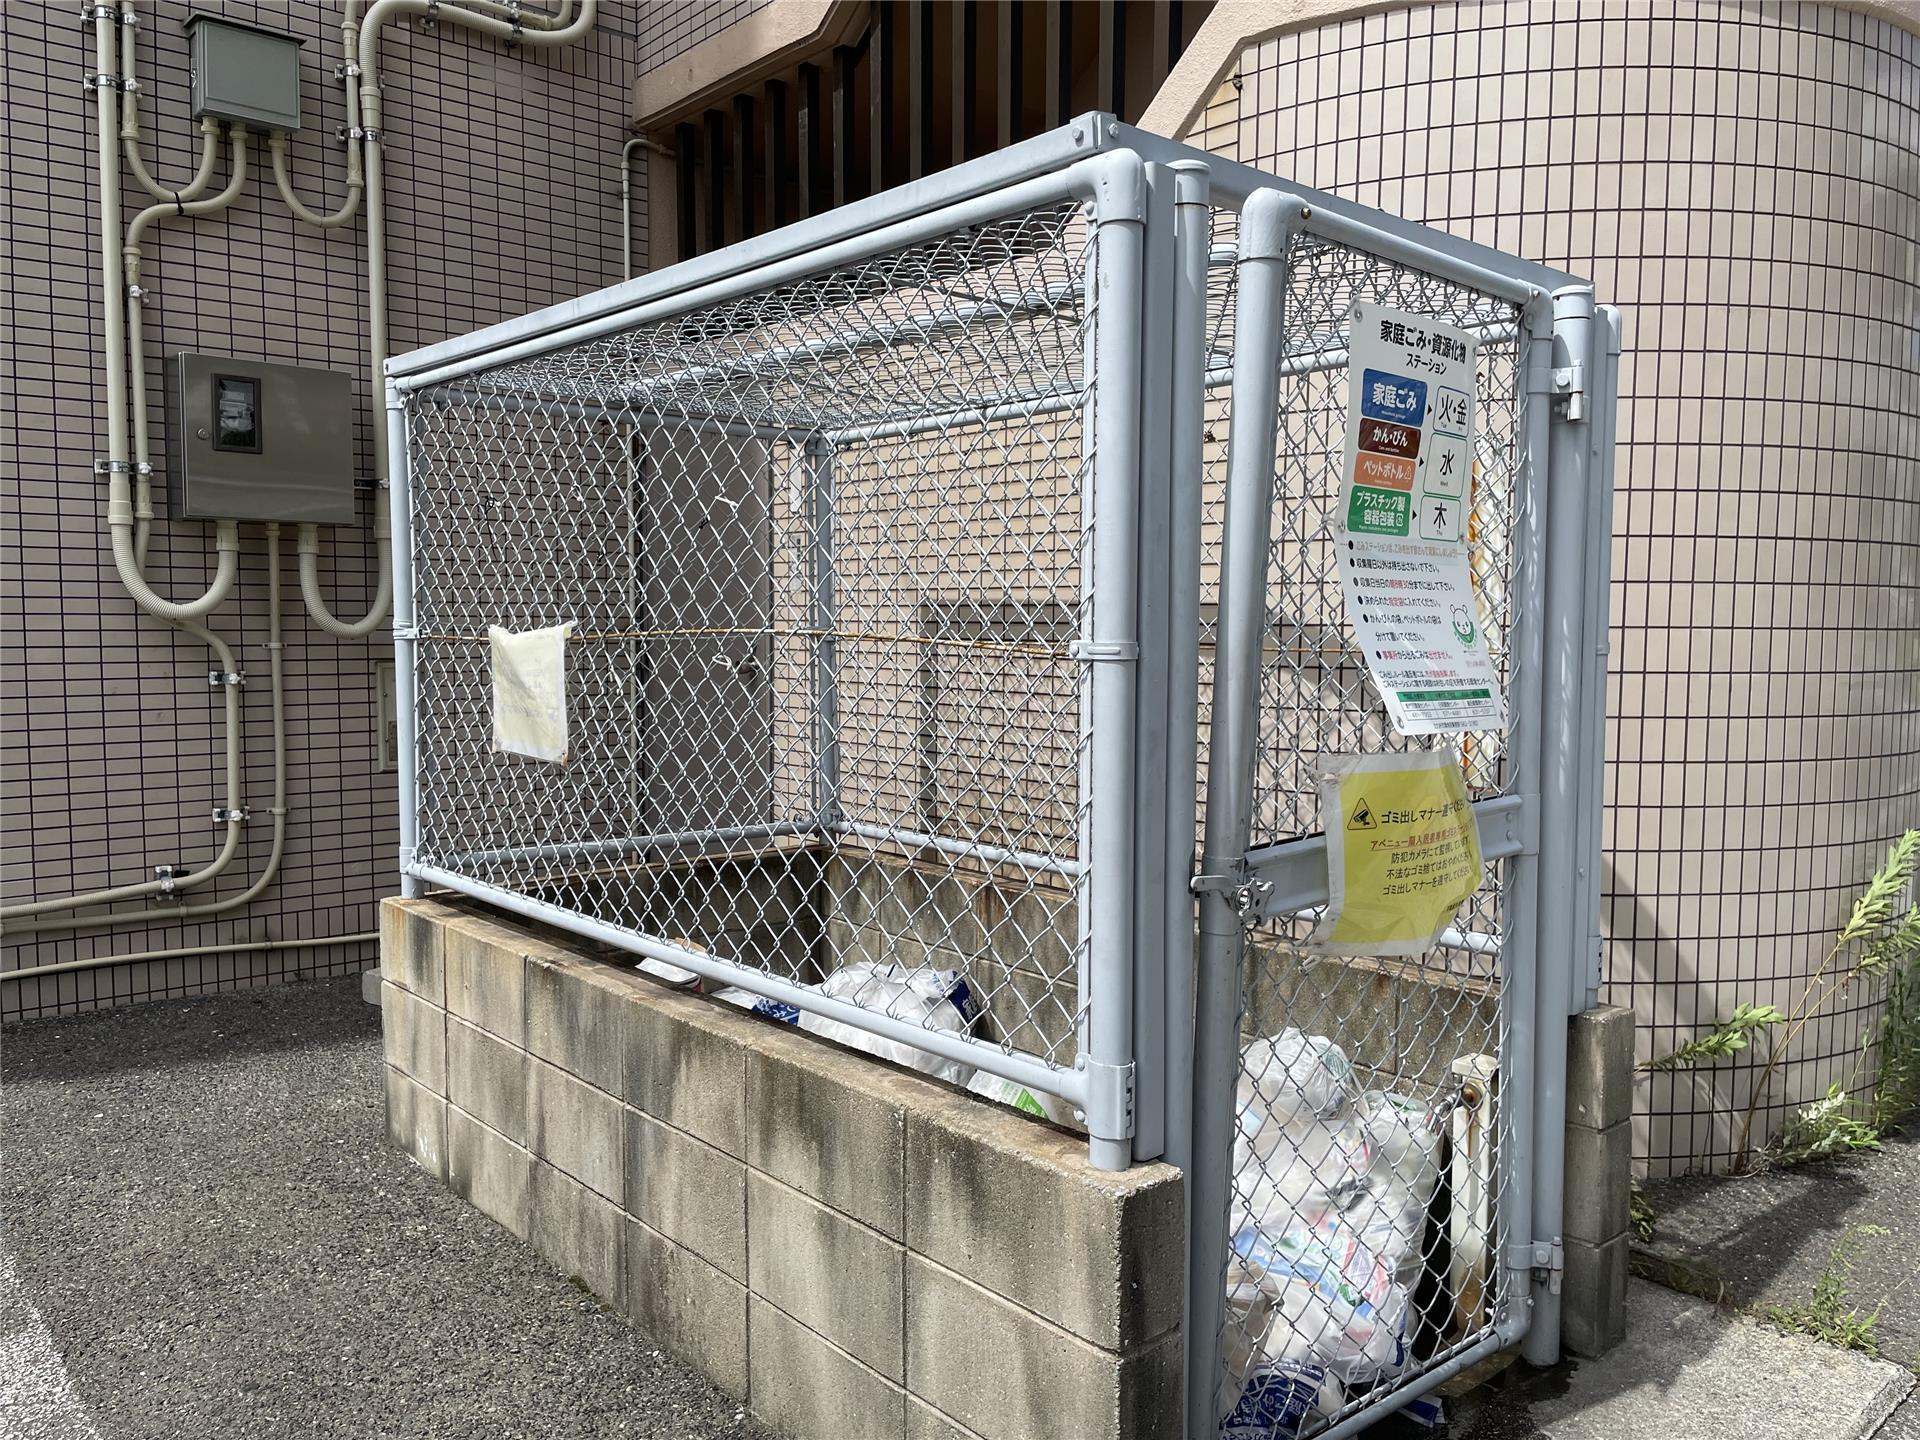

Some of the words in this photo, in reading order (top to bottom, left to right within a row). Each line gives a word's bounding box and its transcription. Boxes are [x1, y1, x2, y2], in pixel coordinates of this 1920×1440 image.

[1380, 319, 1467, 364] 家庭ごみ・資源化物
[1406, 352, 1447, 375] ステーション
[1372, 382, 1417, 412] 家庭ごみ
[1438, 394, 1467, 426] 火・金
[1372, 425, 1409, 447] かん・びん
[1363, 460, 1404, 480] ペットボトル
[1439, 448, 1455, 476] 水
[1356, 490, 1405, 512] プラスチック製
[1363, 509, 1395, 527] 容器包装
[1433, 502, 1447, 529] 木
